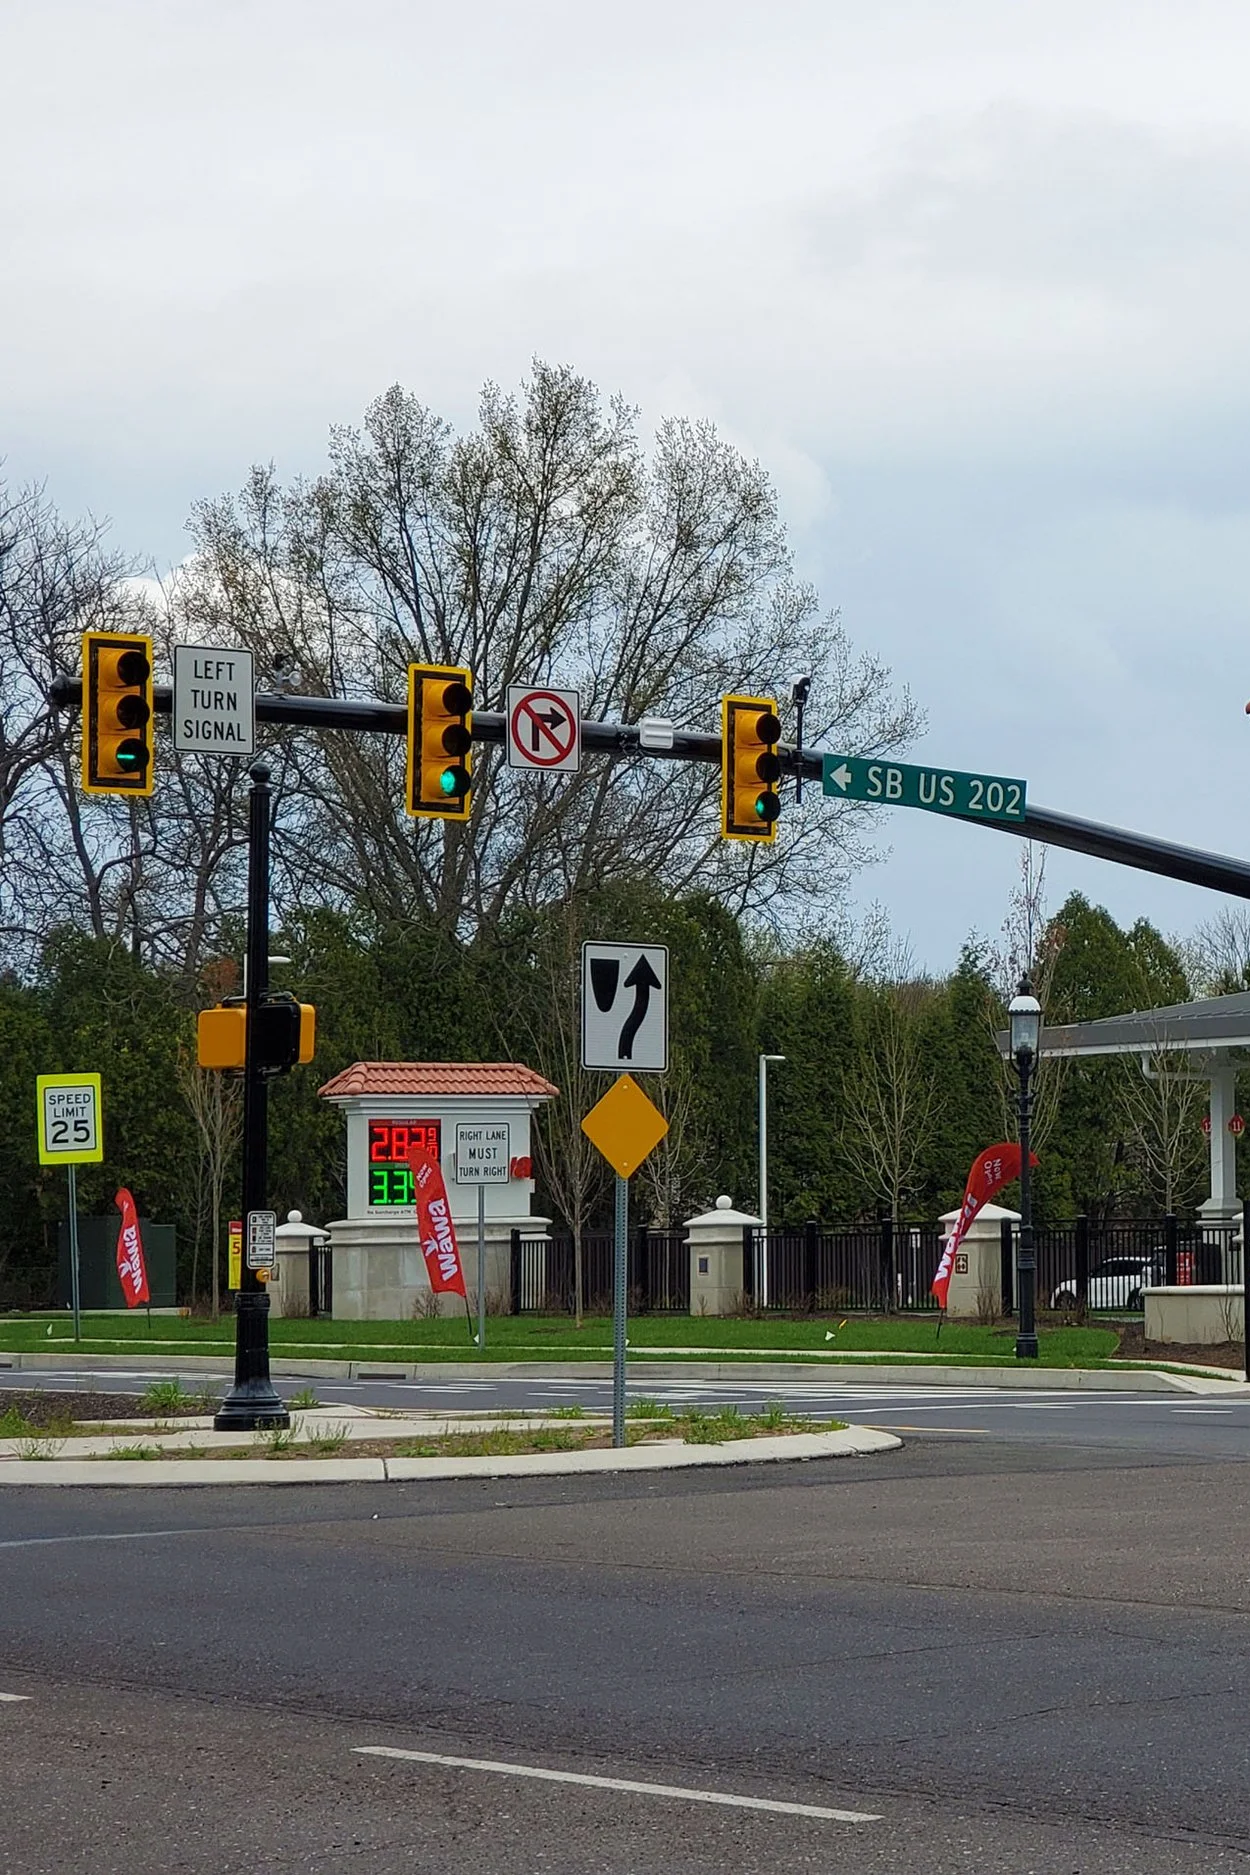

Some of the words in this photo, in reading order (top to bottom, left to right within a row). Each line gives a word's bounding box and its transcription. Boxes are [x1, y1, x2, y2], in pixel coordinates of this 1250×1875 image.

[194, 659, 236, 681] LEFT
[191, 689, 237, 711] TURN
[183, 719, 247, 742] SIGNAL
[866, 766, 903, 799] SB
[919, 772, 955, 806] US
[968, 779, 1021, 815] 202
[48, 1093, 91, 1105] SPEED
[53, 1106, 87, 1118] LIMIT
[51, 1119, 90, 1144] 25
[1232, 1120, 1241, 1131] 11
[459, 1130, 482, 1141] RIGHT
[486, 1130, 507, 1141] LANE
[468, 1147, 498, 1160] MUST
[459, 1166, 480, 1177] TURN
[483, 1166, 507, 1177] RIGHT
